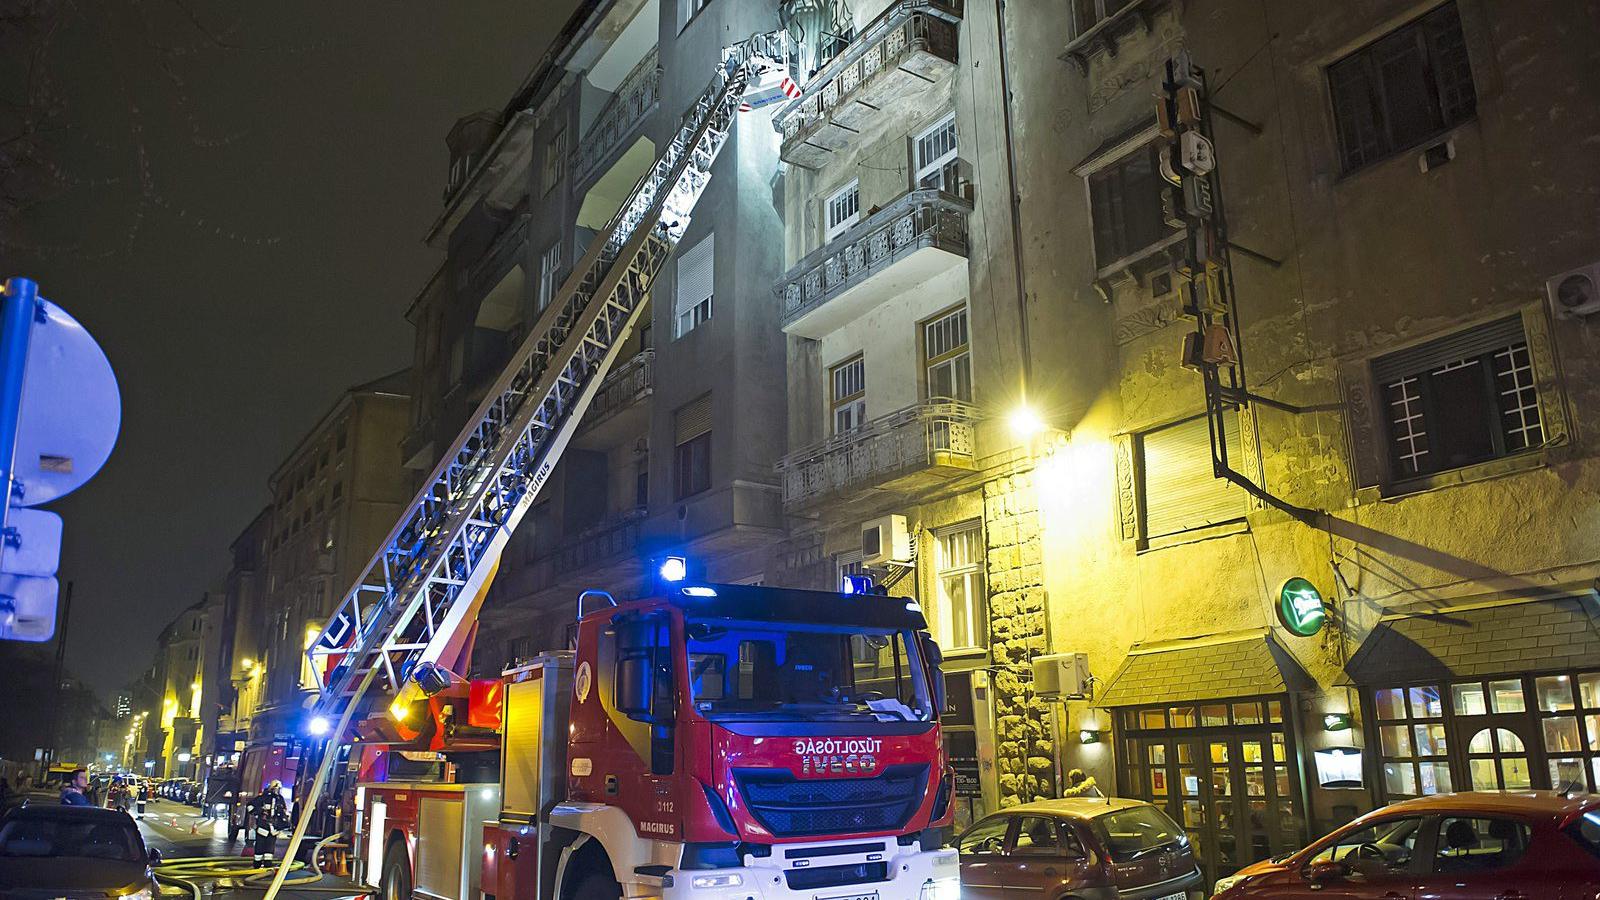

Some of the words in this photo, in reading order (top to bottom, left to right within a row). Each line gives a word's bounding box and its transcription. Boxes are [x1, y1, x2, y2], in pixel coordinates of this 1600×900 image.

[522, 461, 550, 508] MAGIRUS
[802, 754, 876, 774] IVECO
[640, 821, 674, 834] MAGIRUS
